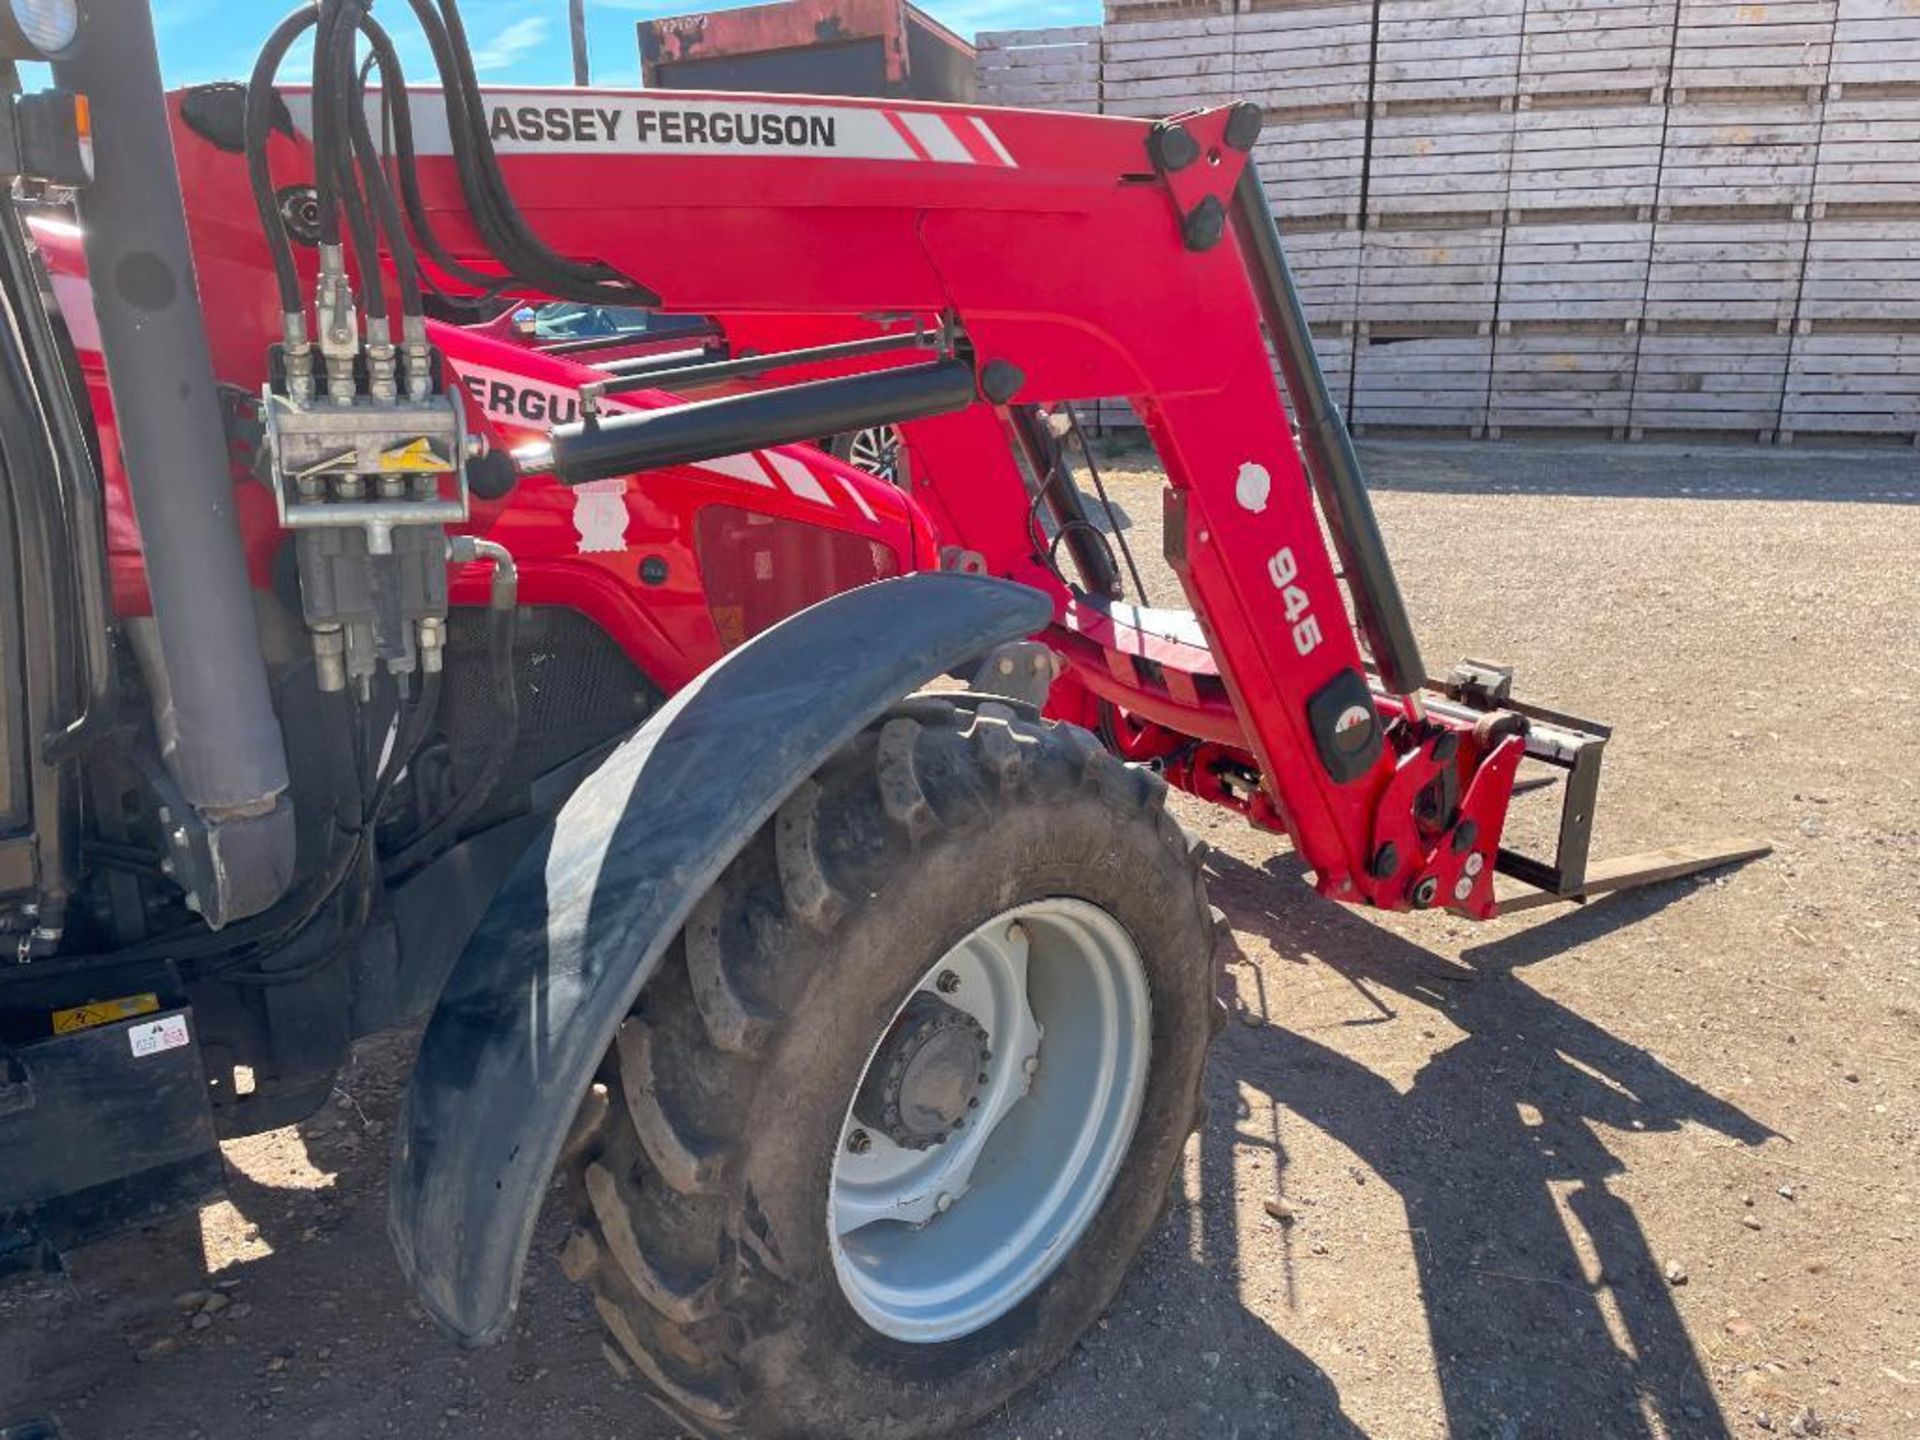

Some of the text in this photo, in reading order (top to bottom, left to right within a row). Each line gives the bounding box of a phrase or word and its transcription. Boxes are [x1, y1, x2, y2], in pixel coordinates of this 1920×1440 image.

[490, 105, 837, 147] ASSEY FERGUSON
[461, 374, 626, 425] ERGU
[1267, 546, 1323, 656] 945
